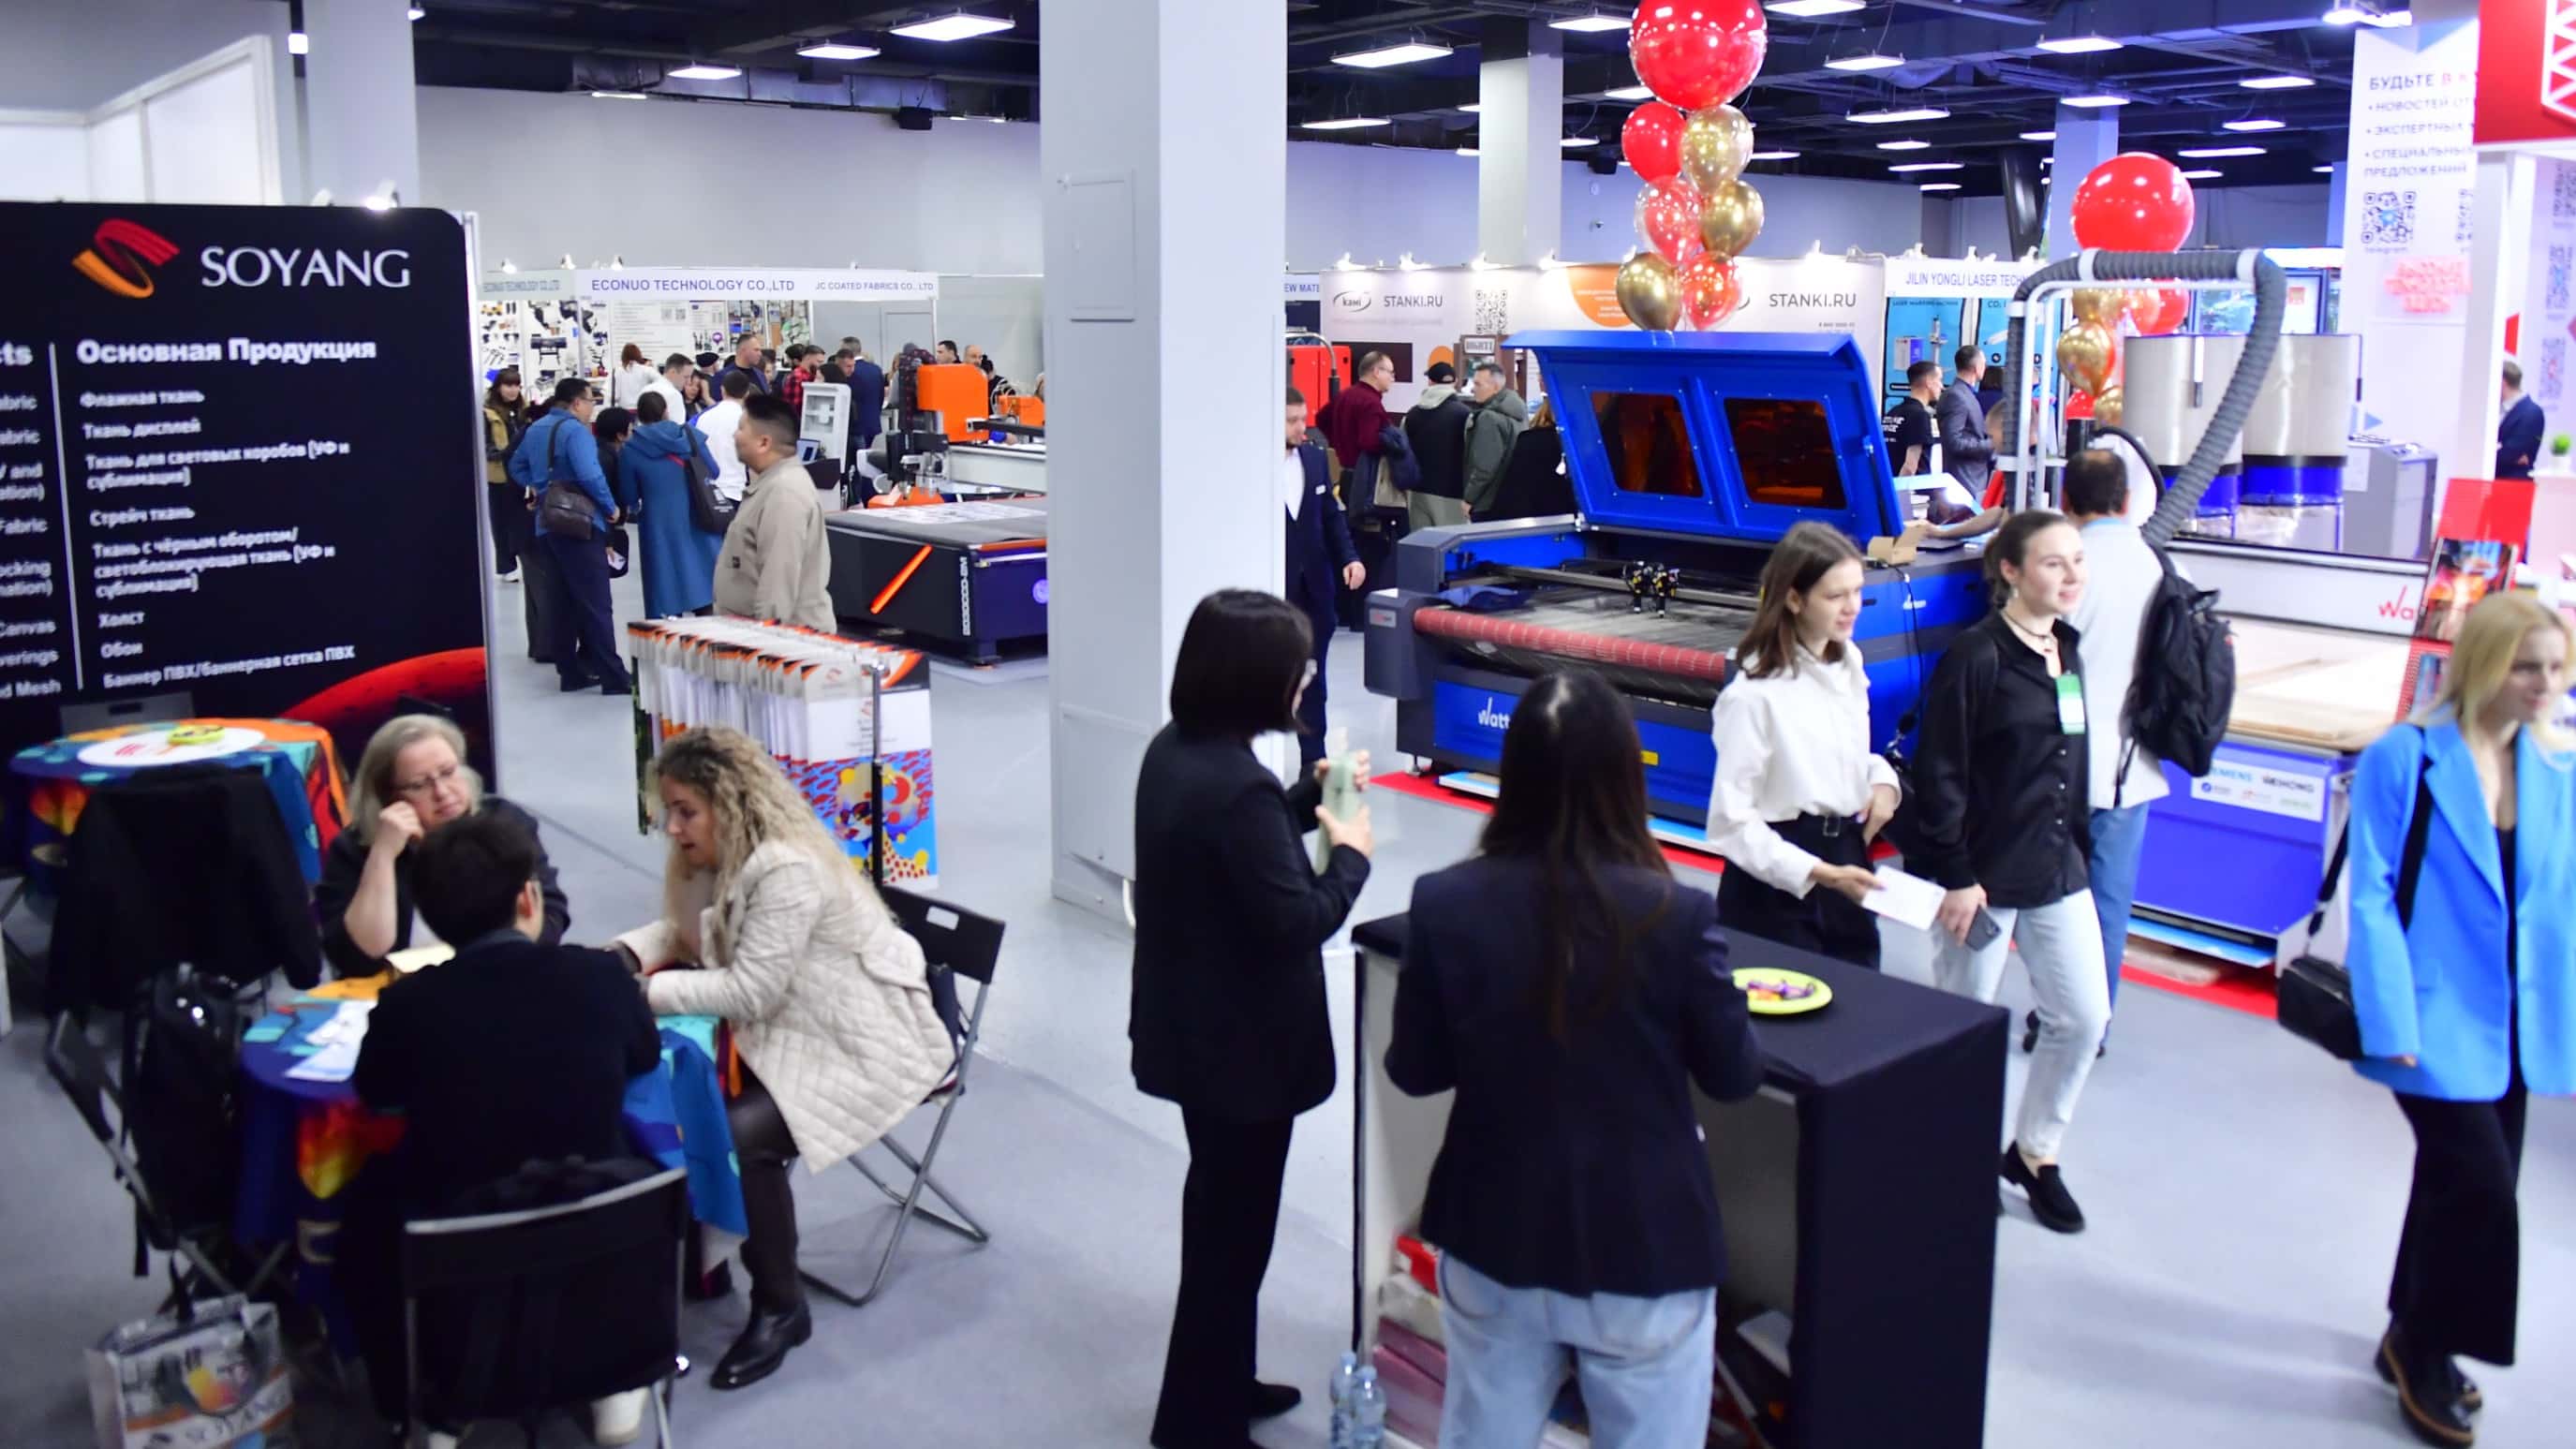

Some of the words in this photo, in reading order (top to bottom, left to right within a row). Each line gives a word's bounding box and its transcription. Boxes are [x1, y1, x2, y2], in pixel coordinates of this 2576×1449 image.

[2369, 74, 2434, 90] БУДЬТЕ
[200, 246, 411, 288] SOYANG
[591, 279, 650, 291] ECONUO
[654, 279, 743, 291] TECHNOLOGY
[828, 281, 862, 291] COATED
[864, 282, 899, 291] FABRICS
[1284, 283, 1296, 293] EW
[1299, 284, 1320, 293] MATE
[1906, 272, 1928, 286] JILIN
[1931, 273, 1965, 286] YONGLI
[1968, 274, 1998, 287] LASER
[1384, 294, 1443, 308] STANKI.RU
[1769, 293, 1857, 308] STANKI.RU
[76, 339, 223, 364] Основная
[228, 337, 377, 366] Продукция
[82, 422, 132, 440] Ткань
[85, 454, 134, 470] Ткань
[243, 442, 306, 463] коробов
[338, 442, 351, 455] и
[89, 508, 148, 529] Стрейч
[149, 507, 195, 522] ткань
[92, 542, 141, 558] Ткань
[141, 541, 153, 554] с
[248, 549, 292, 564] ткань
[323, 545, 336, 557] и
[97, 611, 145, 629] Холст
[100, 641, 143, 659] Обои
[103, 669, 162, 689] Баннер
[282, 649, 324, 667] сетка
[324, 643, 356, 662] ПВХ
[15, 679, 62, 698] Mesh
[1478, 696, 1511, 730] Watt
